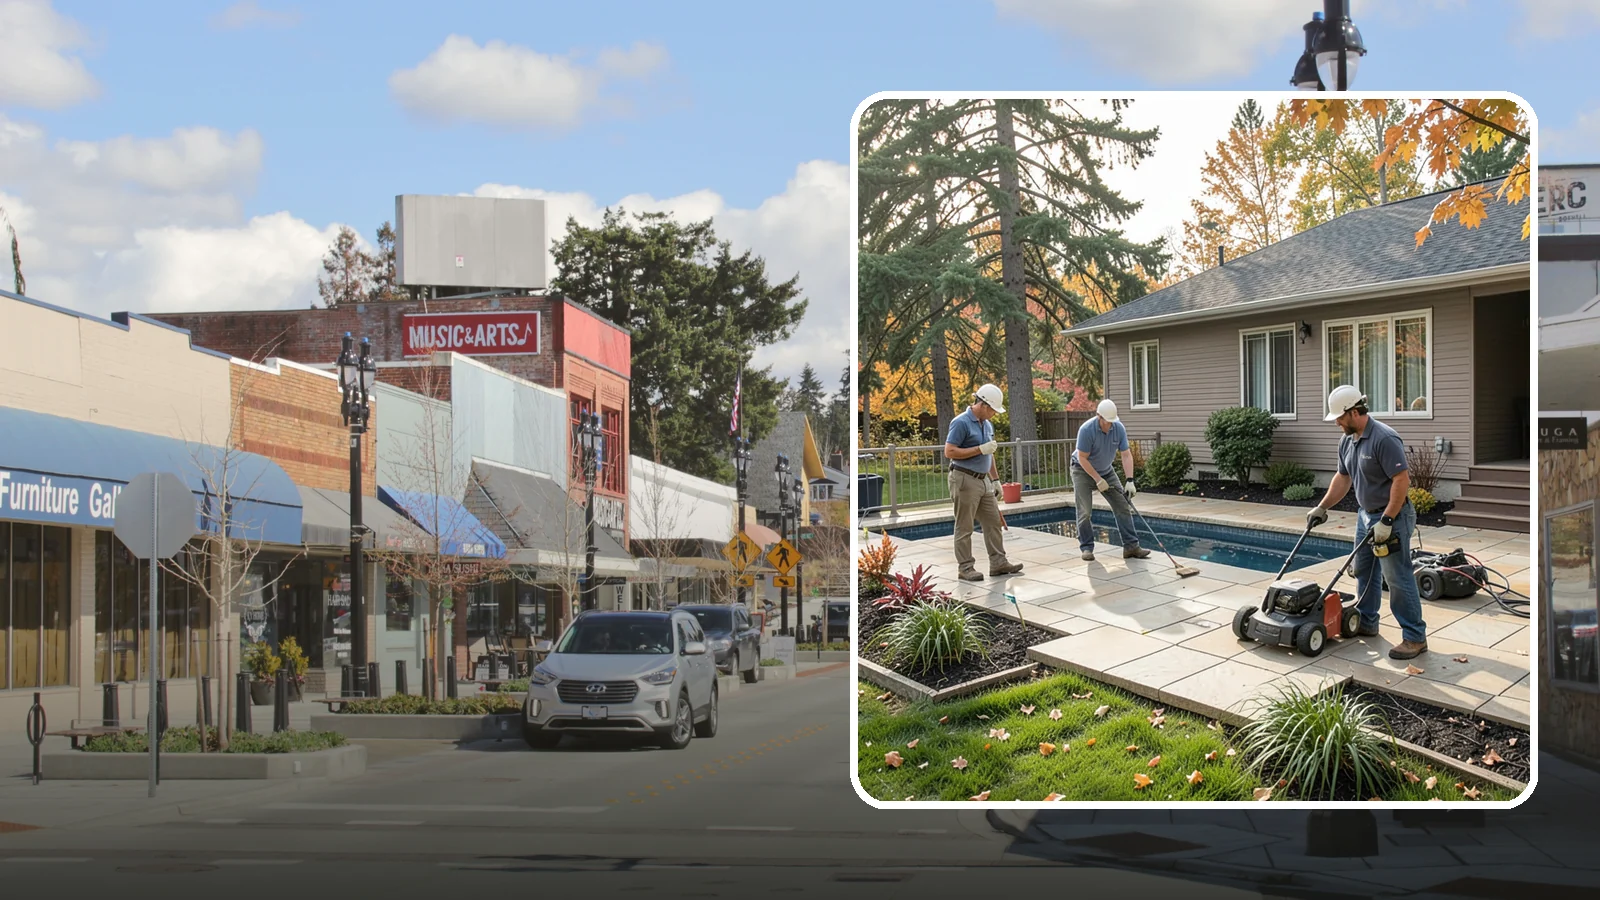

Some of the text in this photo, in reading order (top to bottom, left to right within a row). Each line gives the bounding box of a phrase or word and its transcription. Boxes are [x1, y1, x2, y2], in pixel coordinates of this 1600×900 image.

[409, 323, 519, 348] MUSIC&ARTS
[0, 472, 122, 519] Furniture Gal
[453, 564, 479, 575] SUSHI
